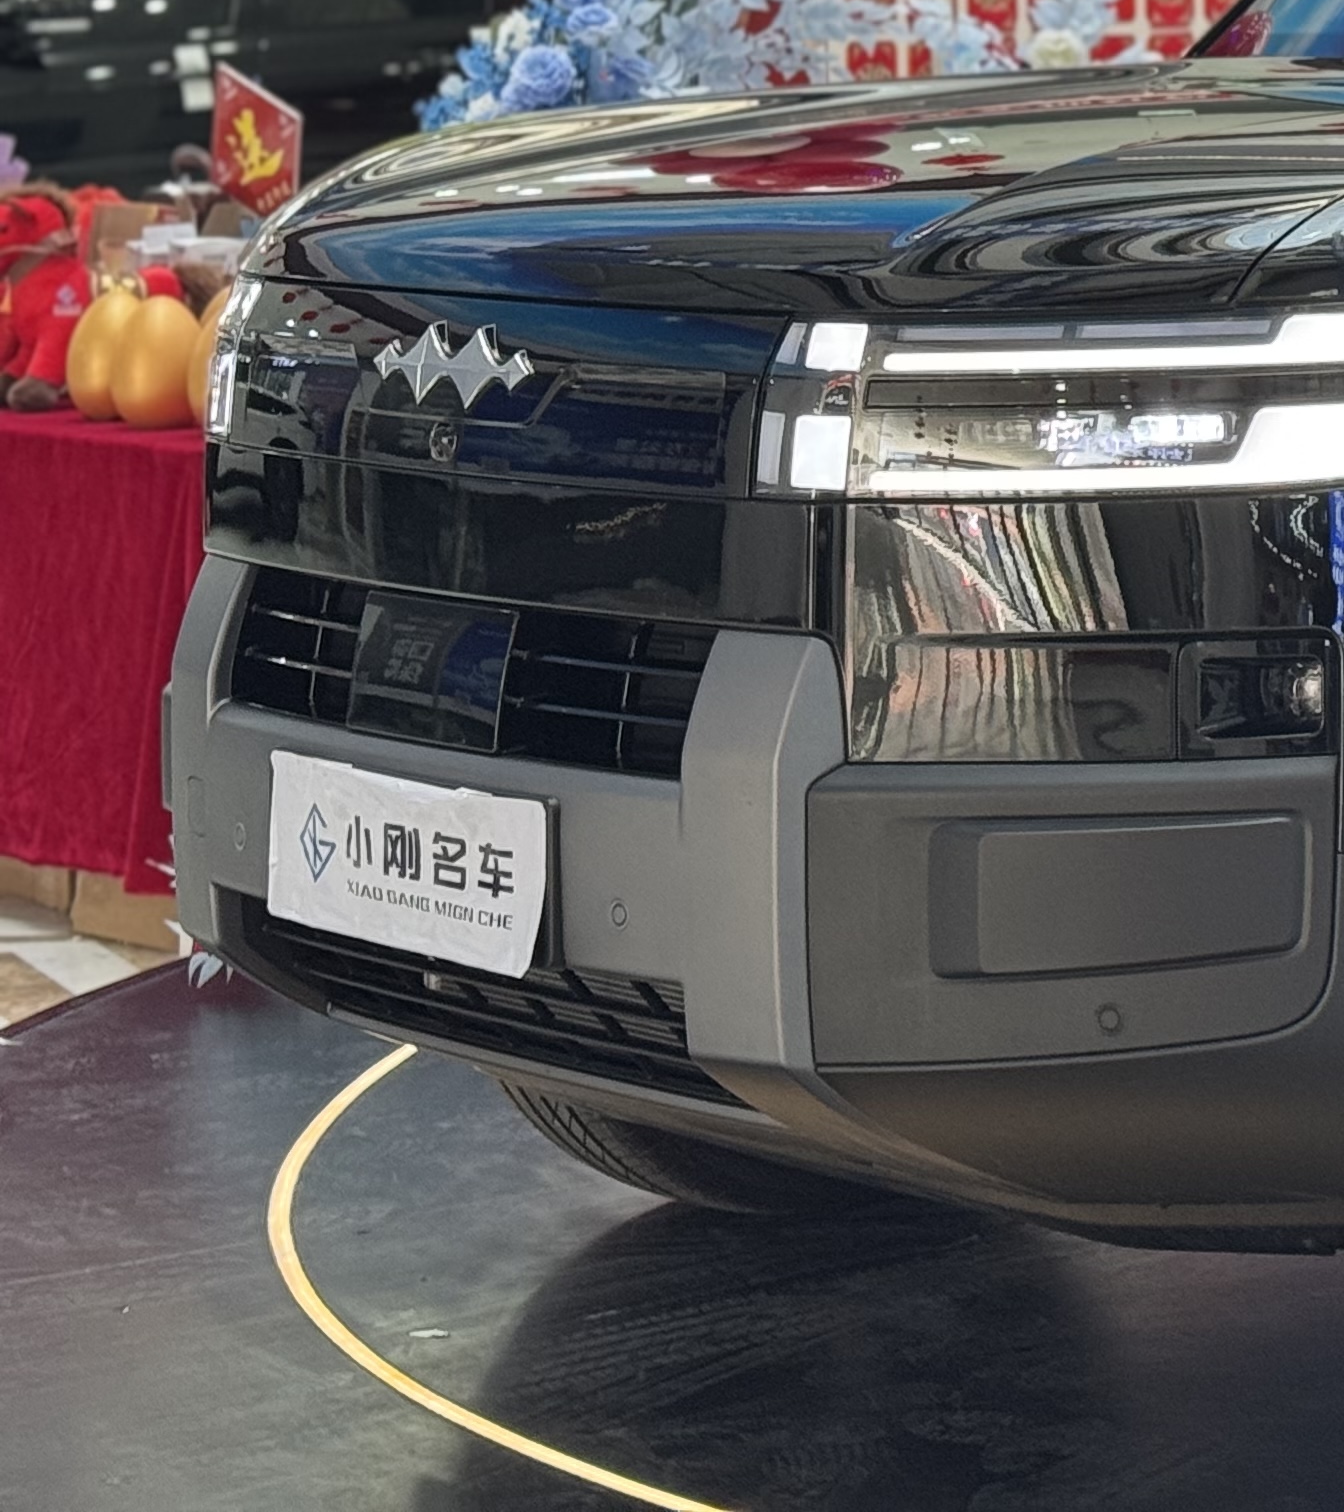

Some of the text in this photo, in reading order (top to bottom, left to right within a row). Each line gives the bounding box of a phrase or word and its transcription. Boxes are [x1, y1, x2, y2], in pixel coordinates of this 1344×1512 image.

[346, 814, 514, 898] 小刚名车
[347, 878, 513, 931] XIAO GANG MIGN CHE
